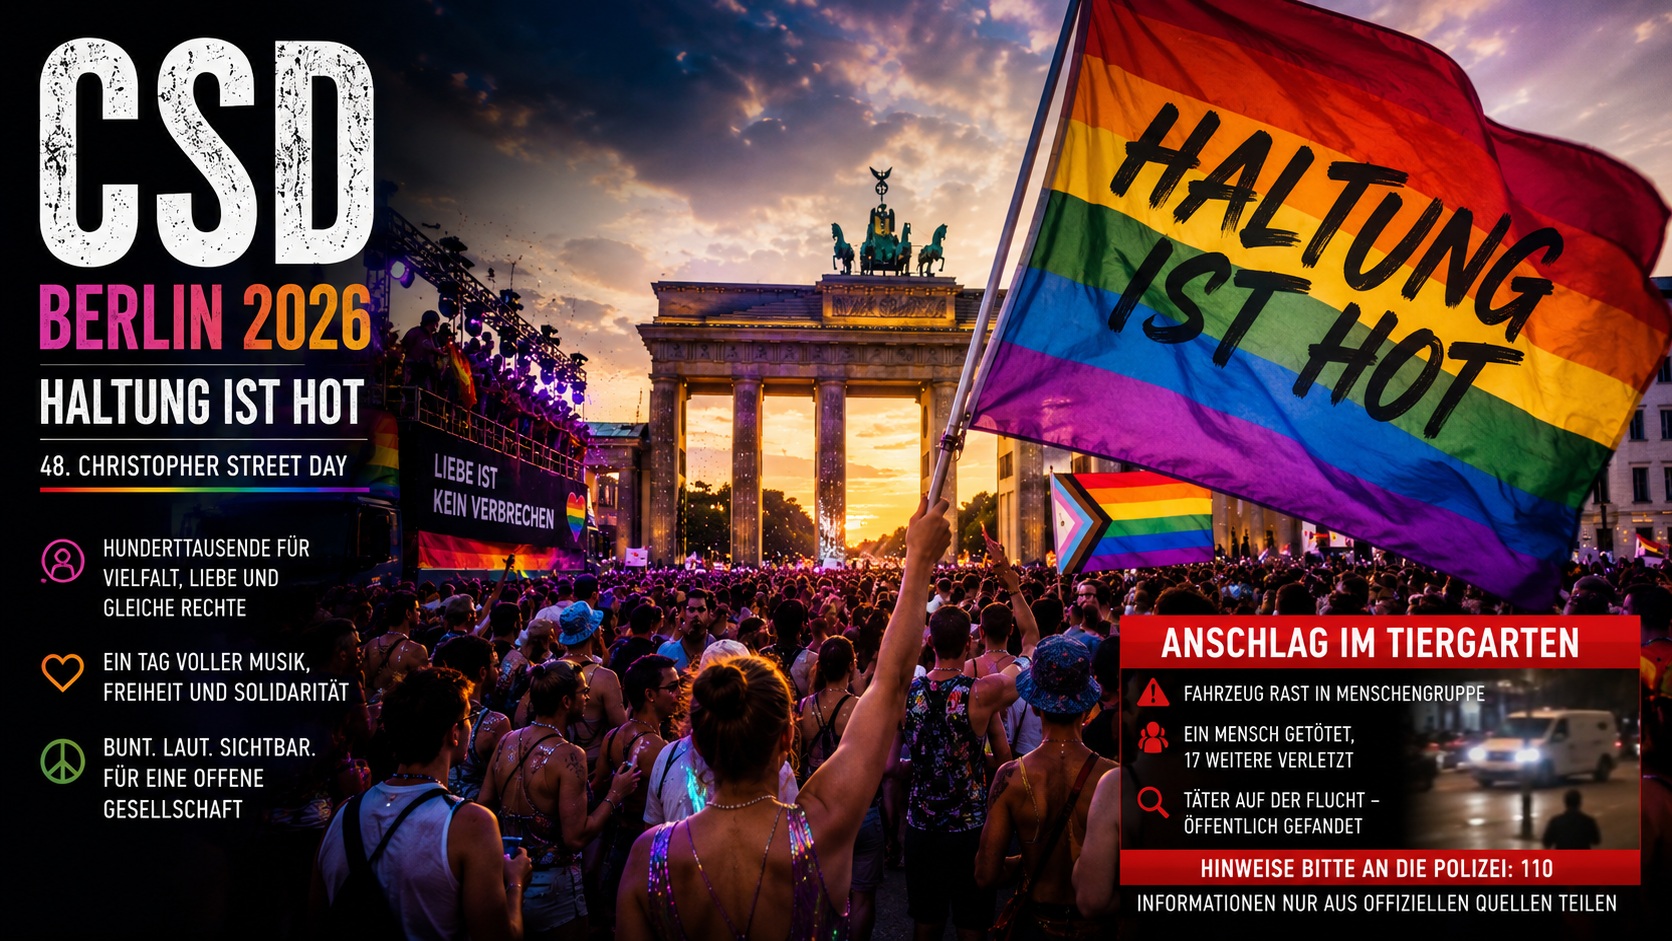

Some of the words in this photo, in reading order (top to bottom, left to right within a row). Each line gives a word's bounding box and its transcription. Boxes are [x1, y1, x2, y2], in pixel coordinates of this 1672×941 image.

[1109, 102, 1564, 343] HALTUNG
[1108, 237, 1312, 369] IST
[1292, 301, 1525, 438] HOT
[433, 488, 467, 517] KEIN
[471, 496, 555, 530] VERBRECHEN
[434, 453, 473, 485] LIEBE
[477, 466, 498, 490] IST
